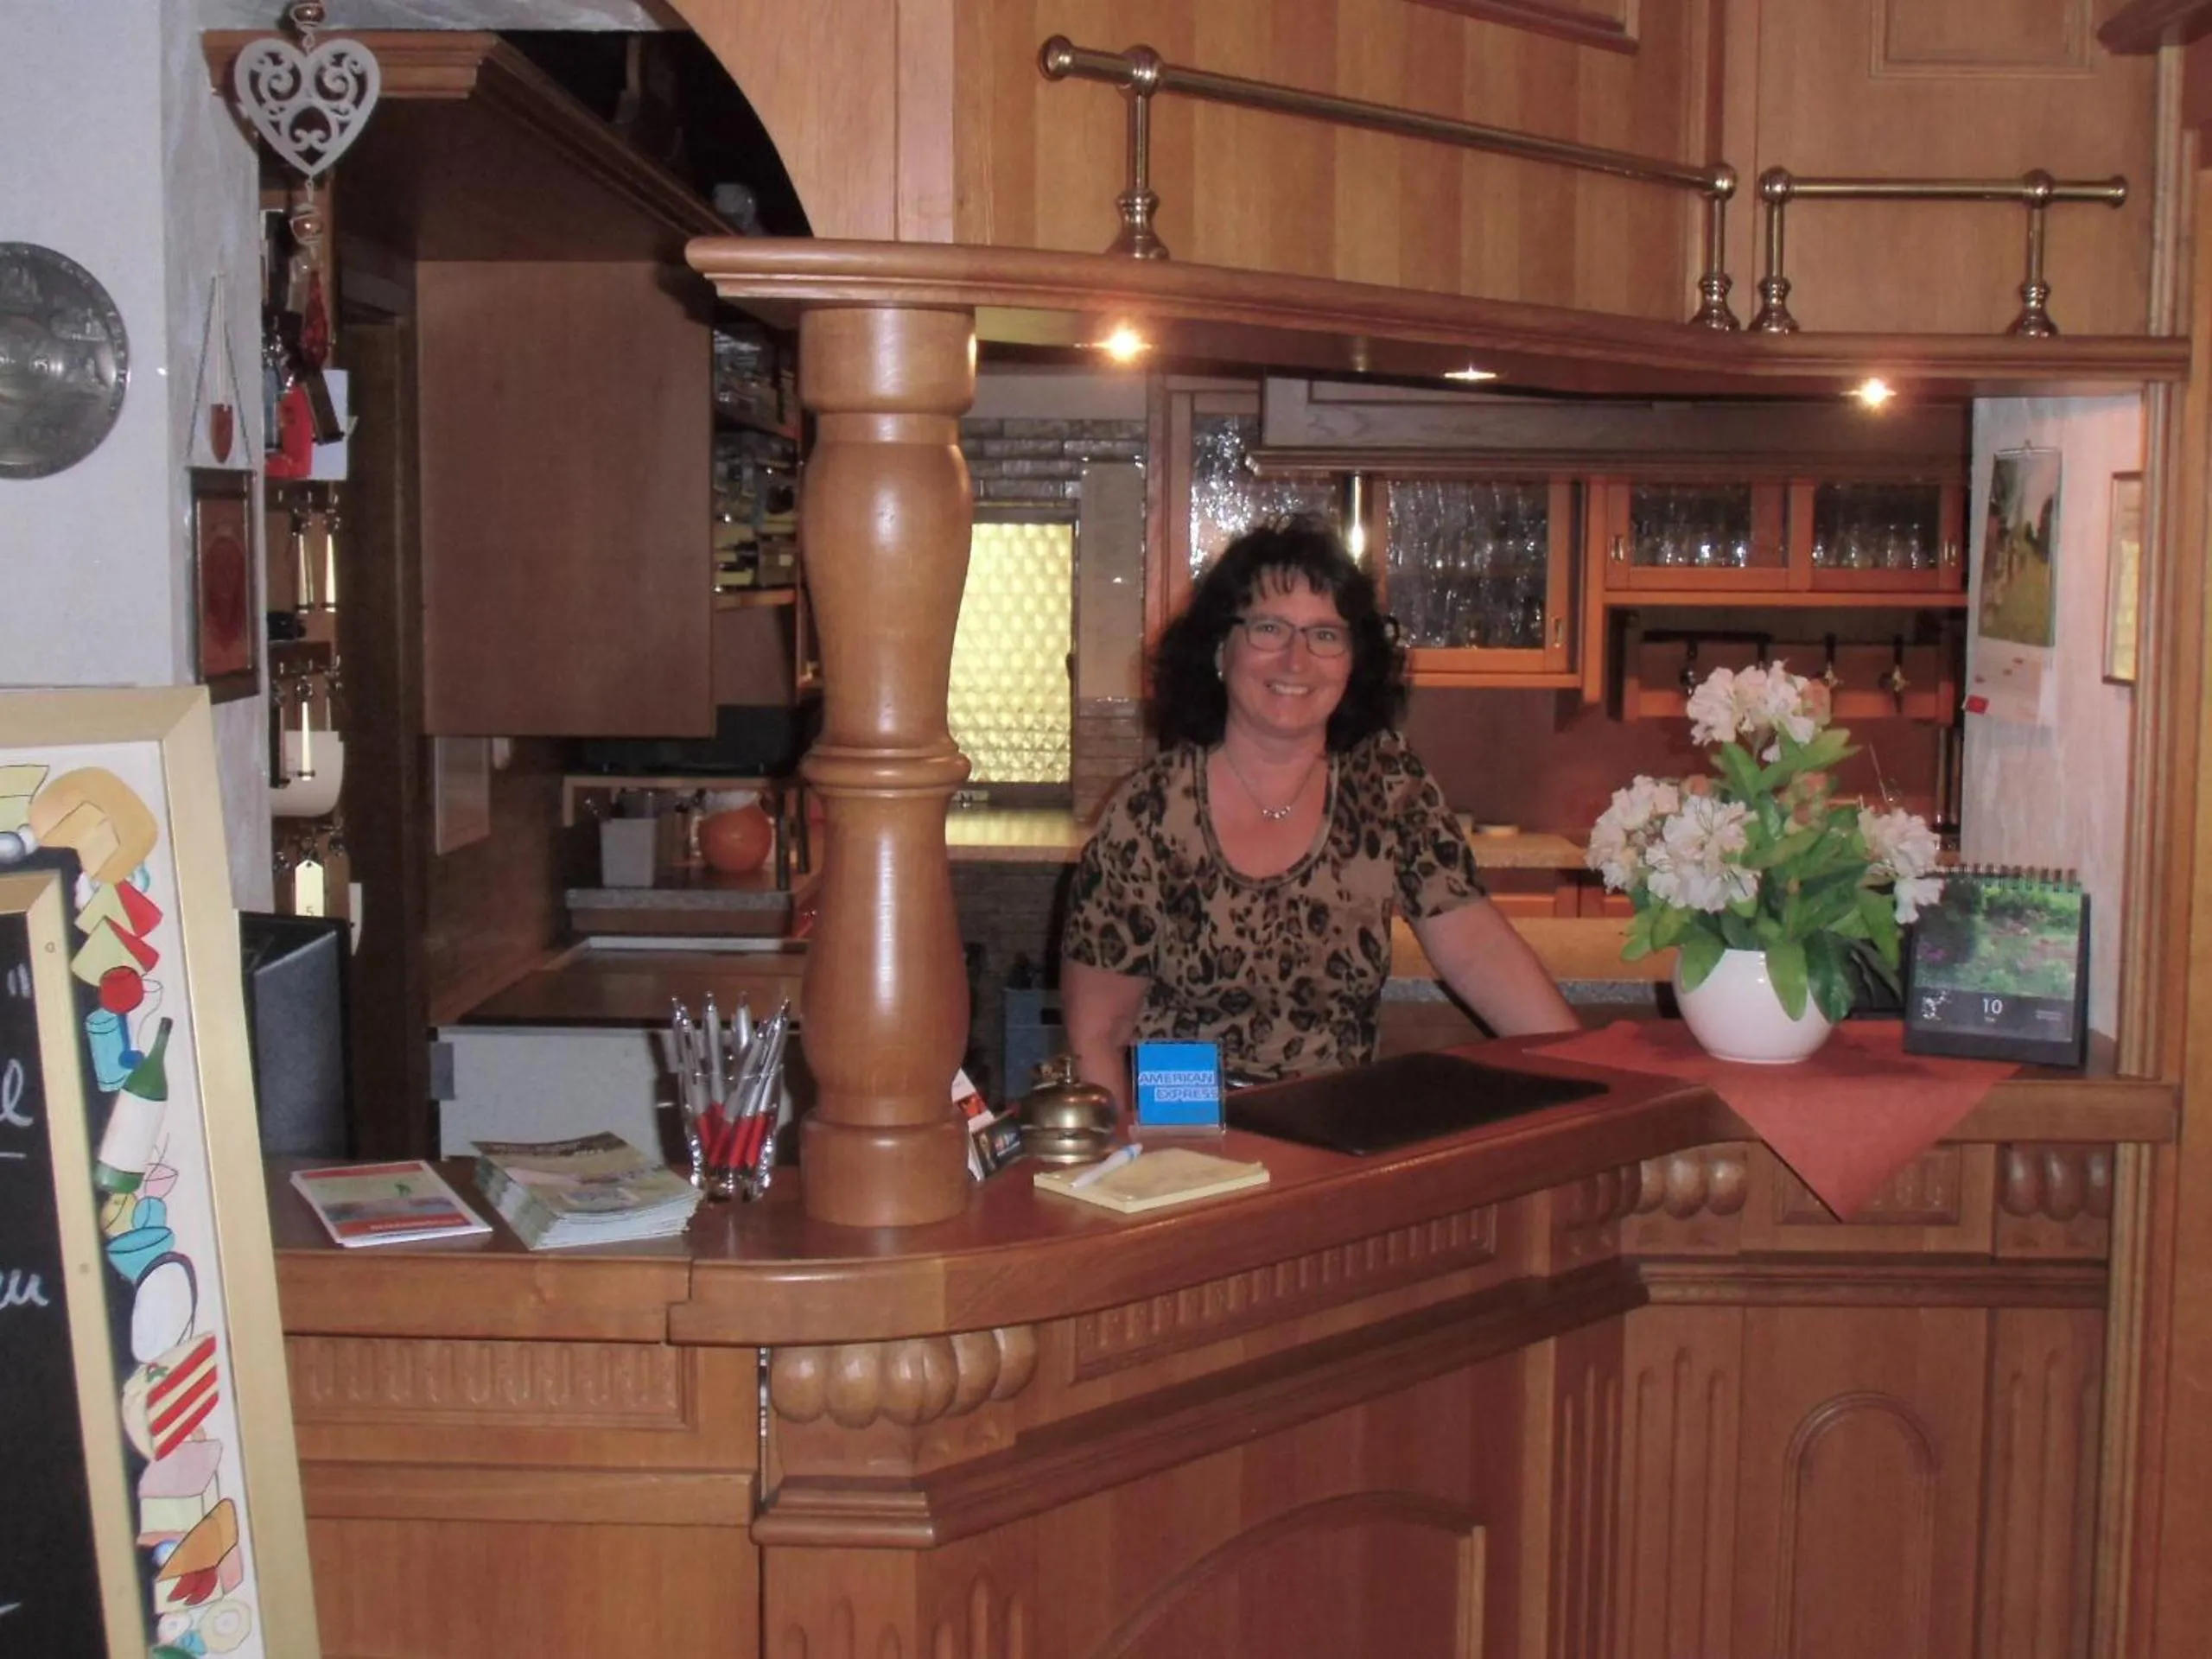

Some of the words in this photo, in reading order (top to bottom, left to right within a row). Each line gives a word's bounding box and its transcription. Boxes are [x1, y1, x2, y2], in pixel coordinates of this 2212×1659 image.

[1983, 997, 2003, 1015] 10
[1139, 1072, 1214, 1084] AMERICAN
[1157, 1088, 1218, 1101] EXPRESS
